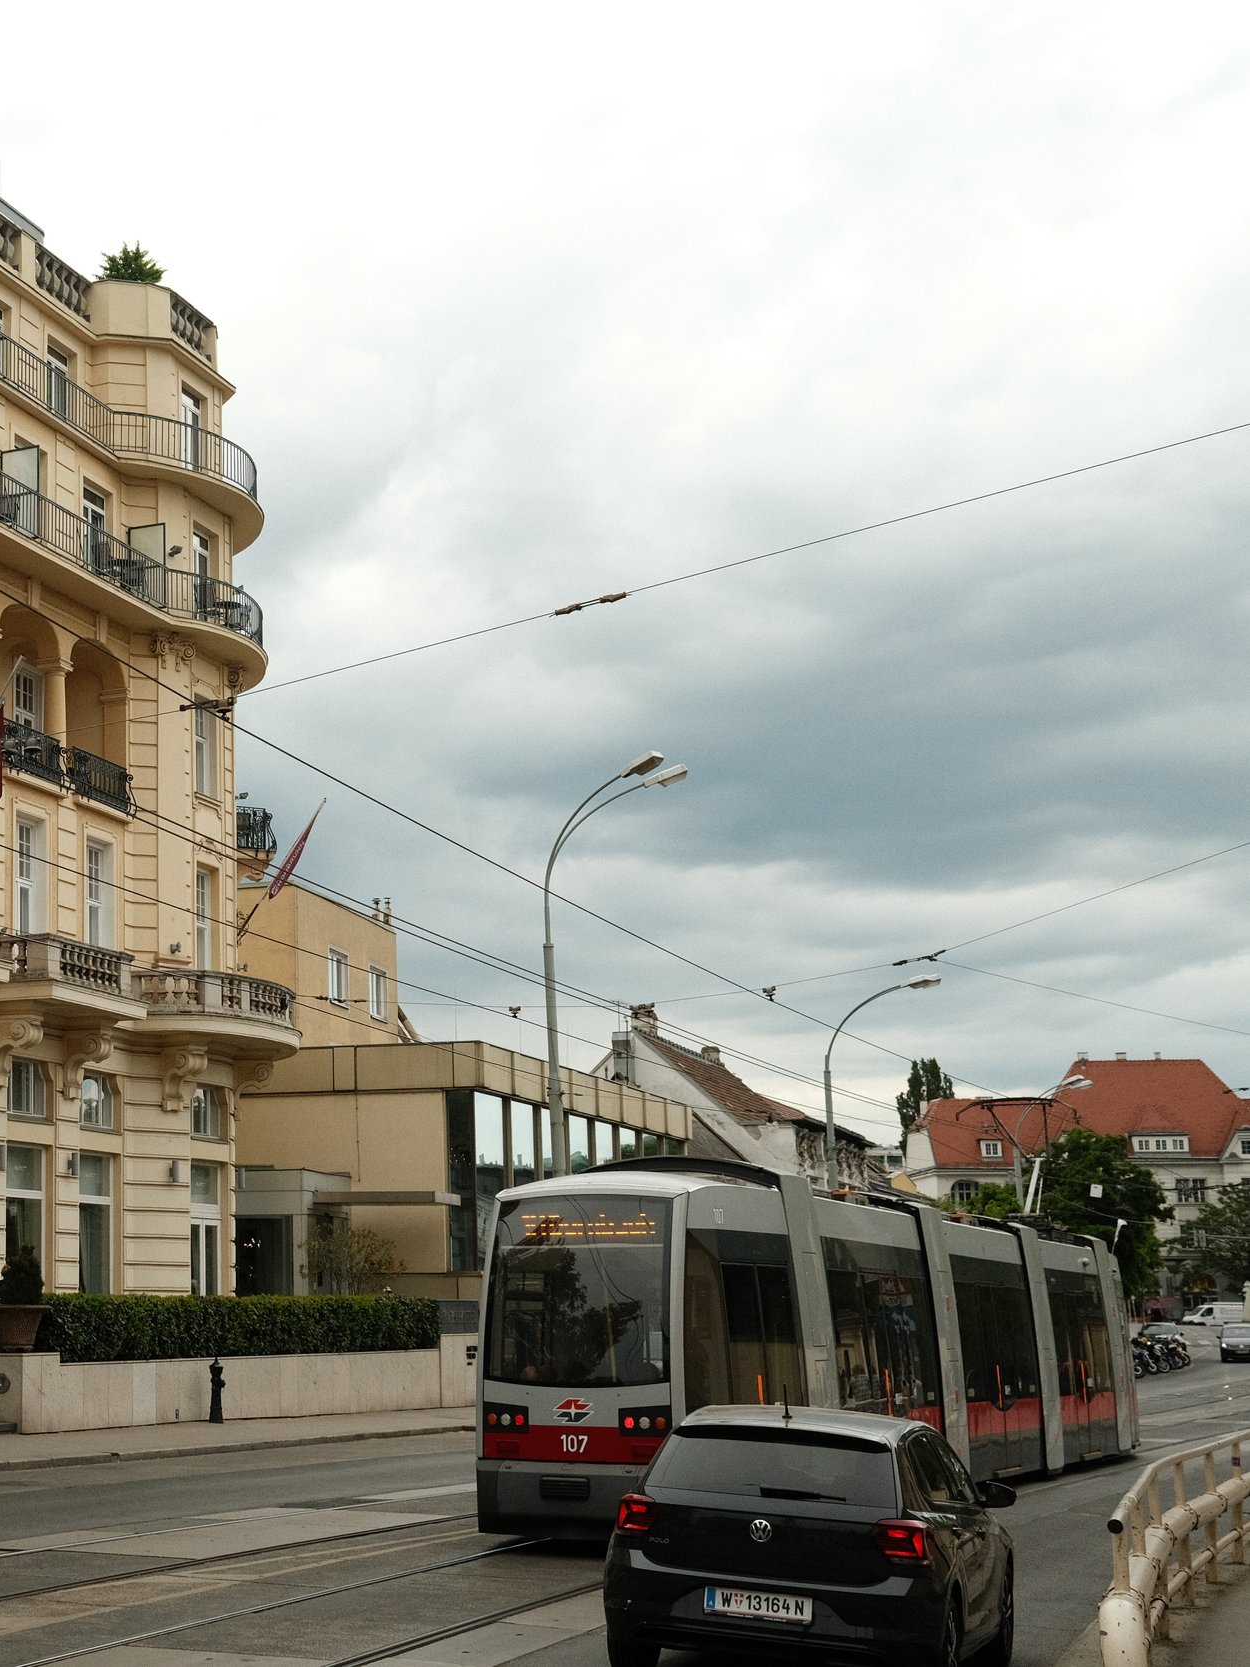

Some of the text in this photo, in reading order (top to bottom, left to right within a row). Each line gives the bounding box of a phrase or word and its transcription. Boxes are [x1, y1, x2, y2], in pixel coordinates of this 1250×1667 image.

[560, 1434, 589, 1453] 107
[721, 1591, 805, 1617] W 13164 N
